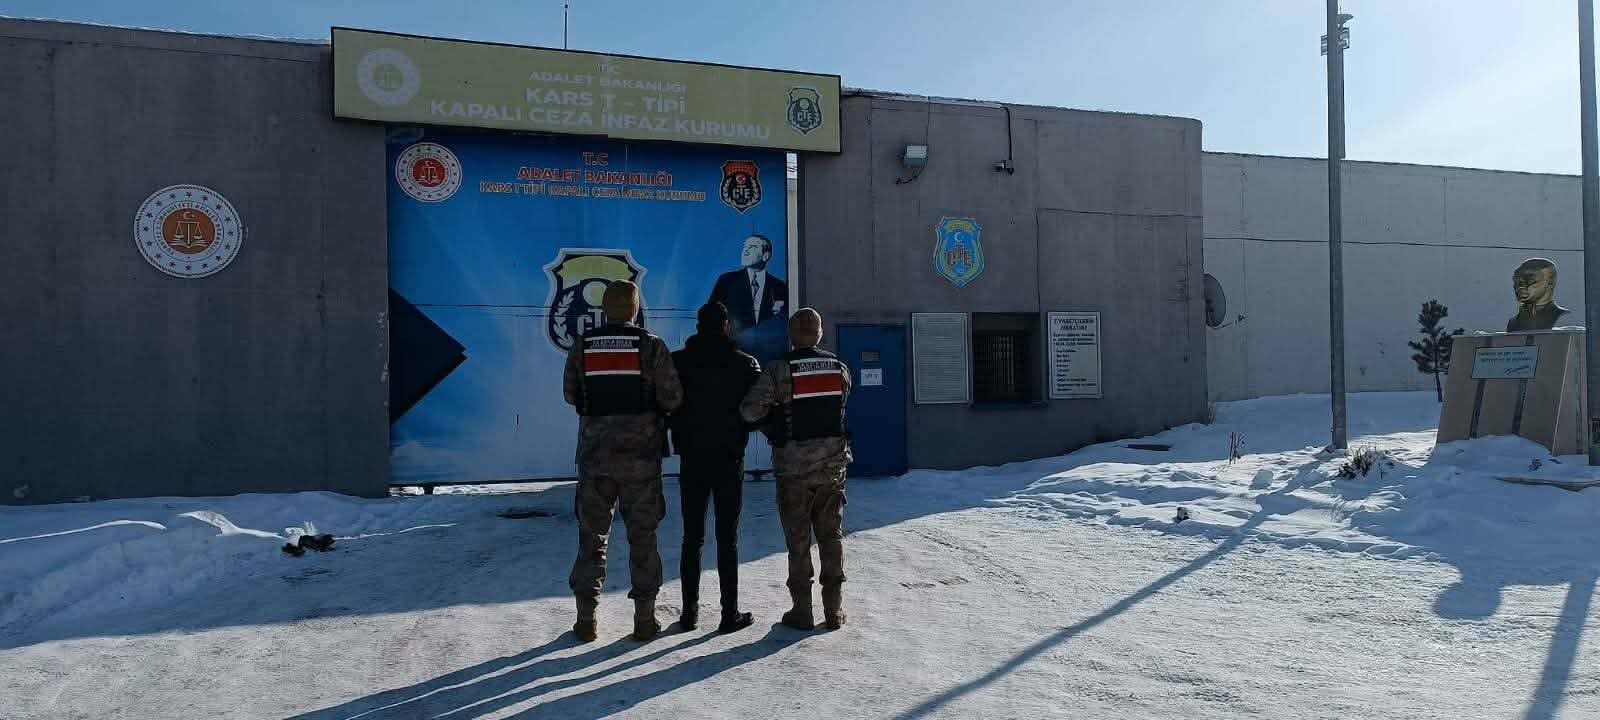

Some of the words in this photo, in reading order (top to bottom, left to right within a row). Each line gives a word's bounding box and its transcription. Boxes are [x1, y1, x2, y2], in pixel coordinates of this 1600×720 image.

[528, 71, 596, 86] ADALET
[599, 78, 687, 94] BAKANLIĞI
[525, 87, 594, 106] KARS
[602, 93, 617, 112] T
[642, 93, 687, 115] TİPİ
[430, 98, 521, 121] KAPALI
[528, 107, 593, 127] CEZA
[601, 111, 670, 133] İNFAZ
[676, 119, 771, 139] KURUMU
[479, 182, 513, 194] KARS
[517, 166, 582, 183] ADALET
[584, 168, 673, 187] BAKANLIĞI
